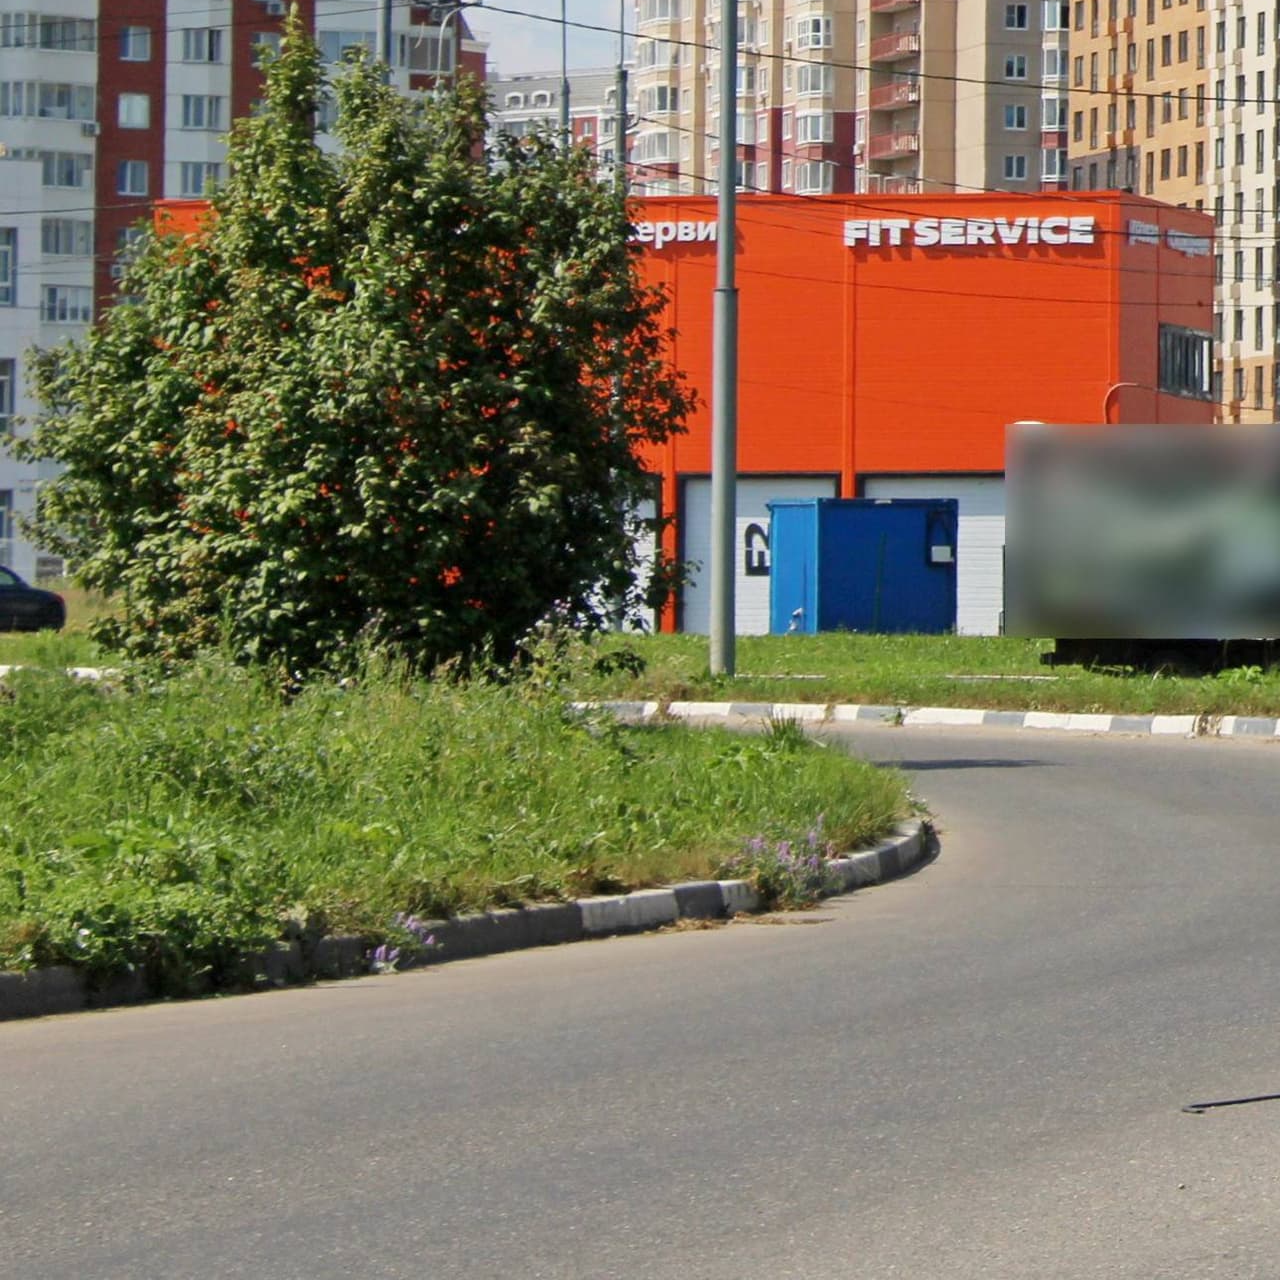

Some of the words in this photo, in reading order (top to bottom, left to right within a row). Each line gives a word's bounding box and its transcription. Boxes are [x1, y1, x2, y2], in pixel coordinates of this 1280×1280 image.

[628, 221, 718, 249] ерви
[843, 219, 909, 247] FIT
[913, 216, 1095, 247] SERVICE
